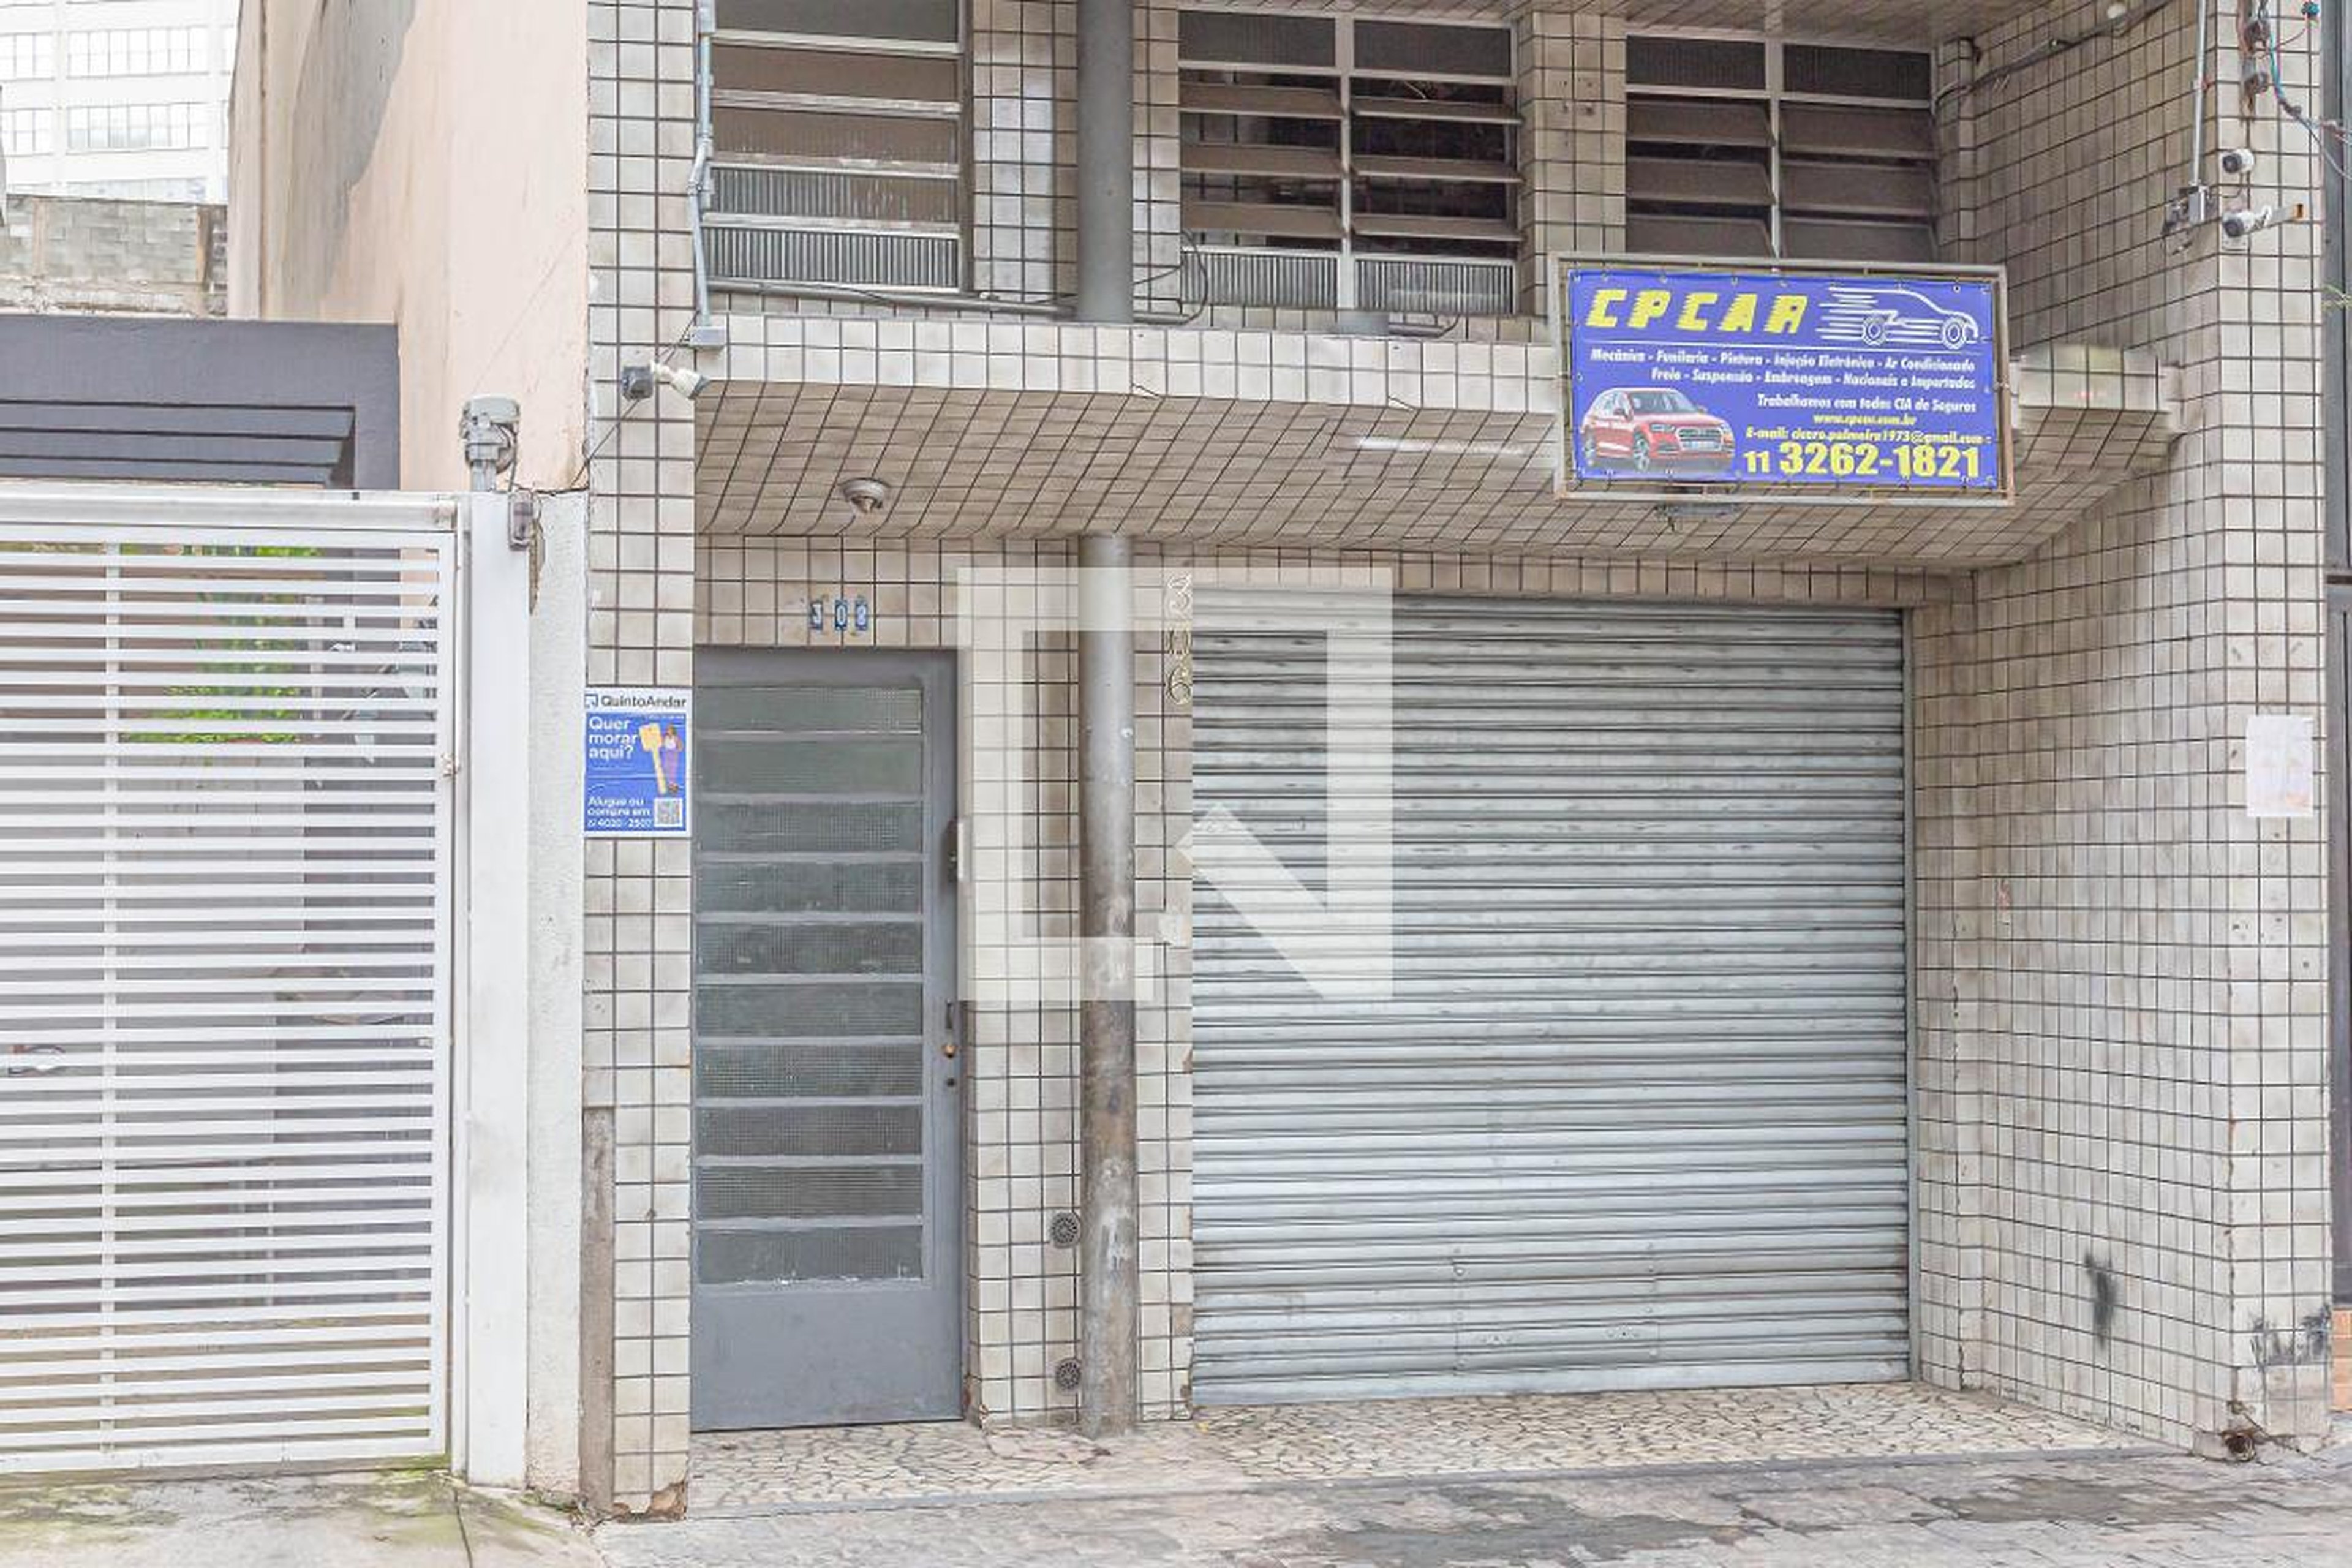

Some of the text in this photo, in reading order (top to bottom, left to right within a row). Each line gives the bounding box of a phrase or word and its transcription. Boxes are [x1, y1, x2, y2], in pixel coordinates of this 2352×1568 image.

[1585, 289, 1807, 333] CPCAR
[1657, 350, 1708, 364] Funilaria
[1720, 352, 1762, 366] Pintura
[1774, 354, 1815, 369] Injeção
[1885, 357, 1898, 369] Ar
[1901, 357, 1975, 372] Condicionado
[1651, 367, 1680, 380] Freio
[1765, 371, 1832, 386] Embreagem
[1843, 373, 1898, 386] Nacionais
[1901, 378, 1907, 386] e
[1911, 375, 1975, 390] Importados
[1758, 394, 1830, 409] Trabalhamos
[1834, 399, 1856, 410] com
[1894, 398, 1912, 410] CIA
[1915, 399, 1929, 412] de
[1931, 400, 1976, 415] Seguros
[1746, 426, 1789, 440] E-mail:
[1744, 441, 1980, 478] 11 3262-1821
[601, 695, 687, 707] QuintoAndar
[589, 716, 631, 730] Quer
[589, 734, 638, 744] morar
[589, 746, 634, 761] aqui?
